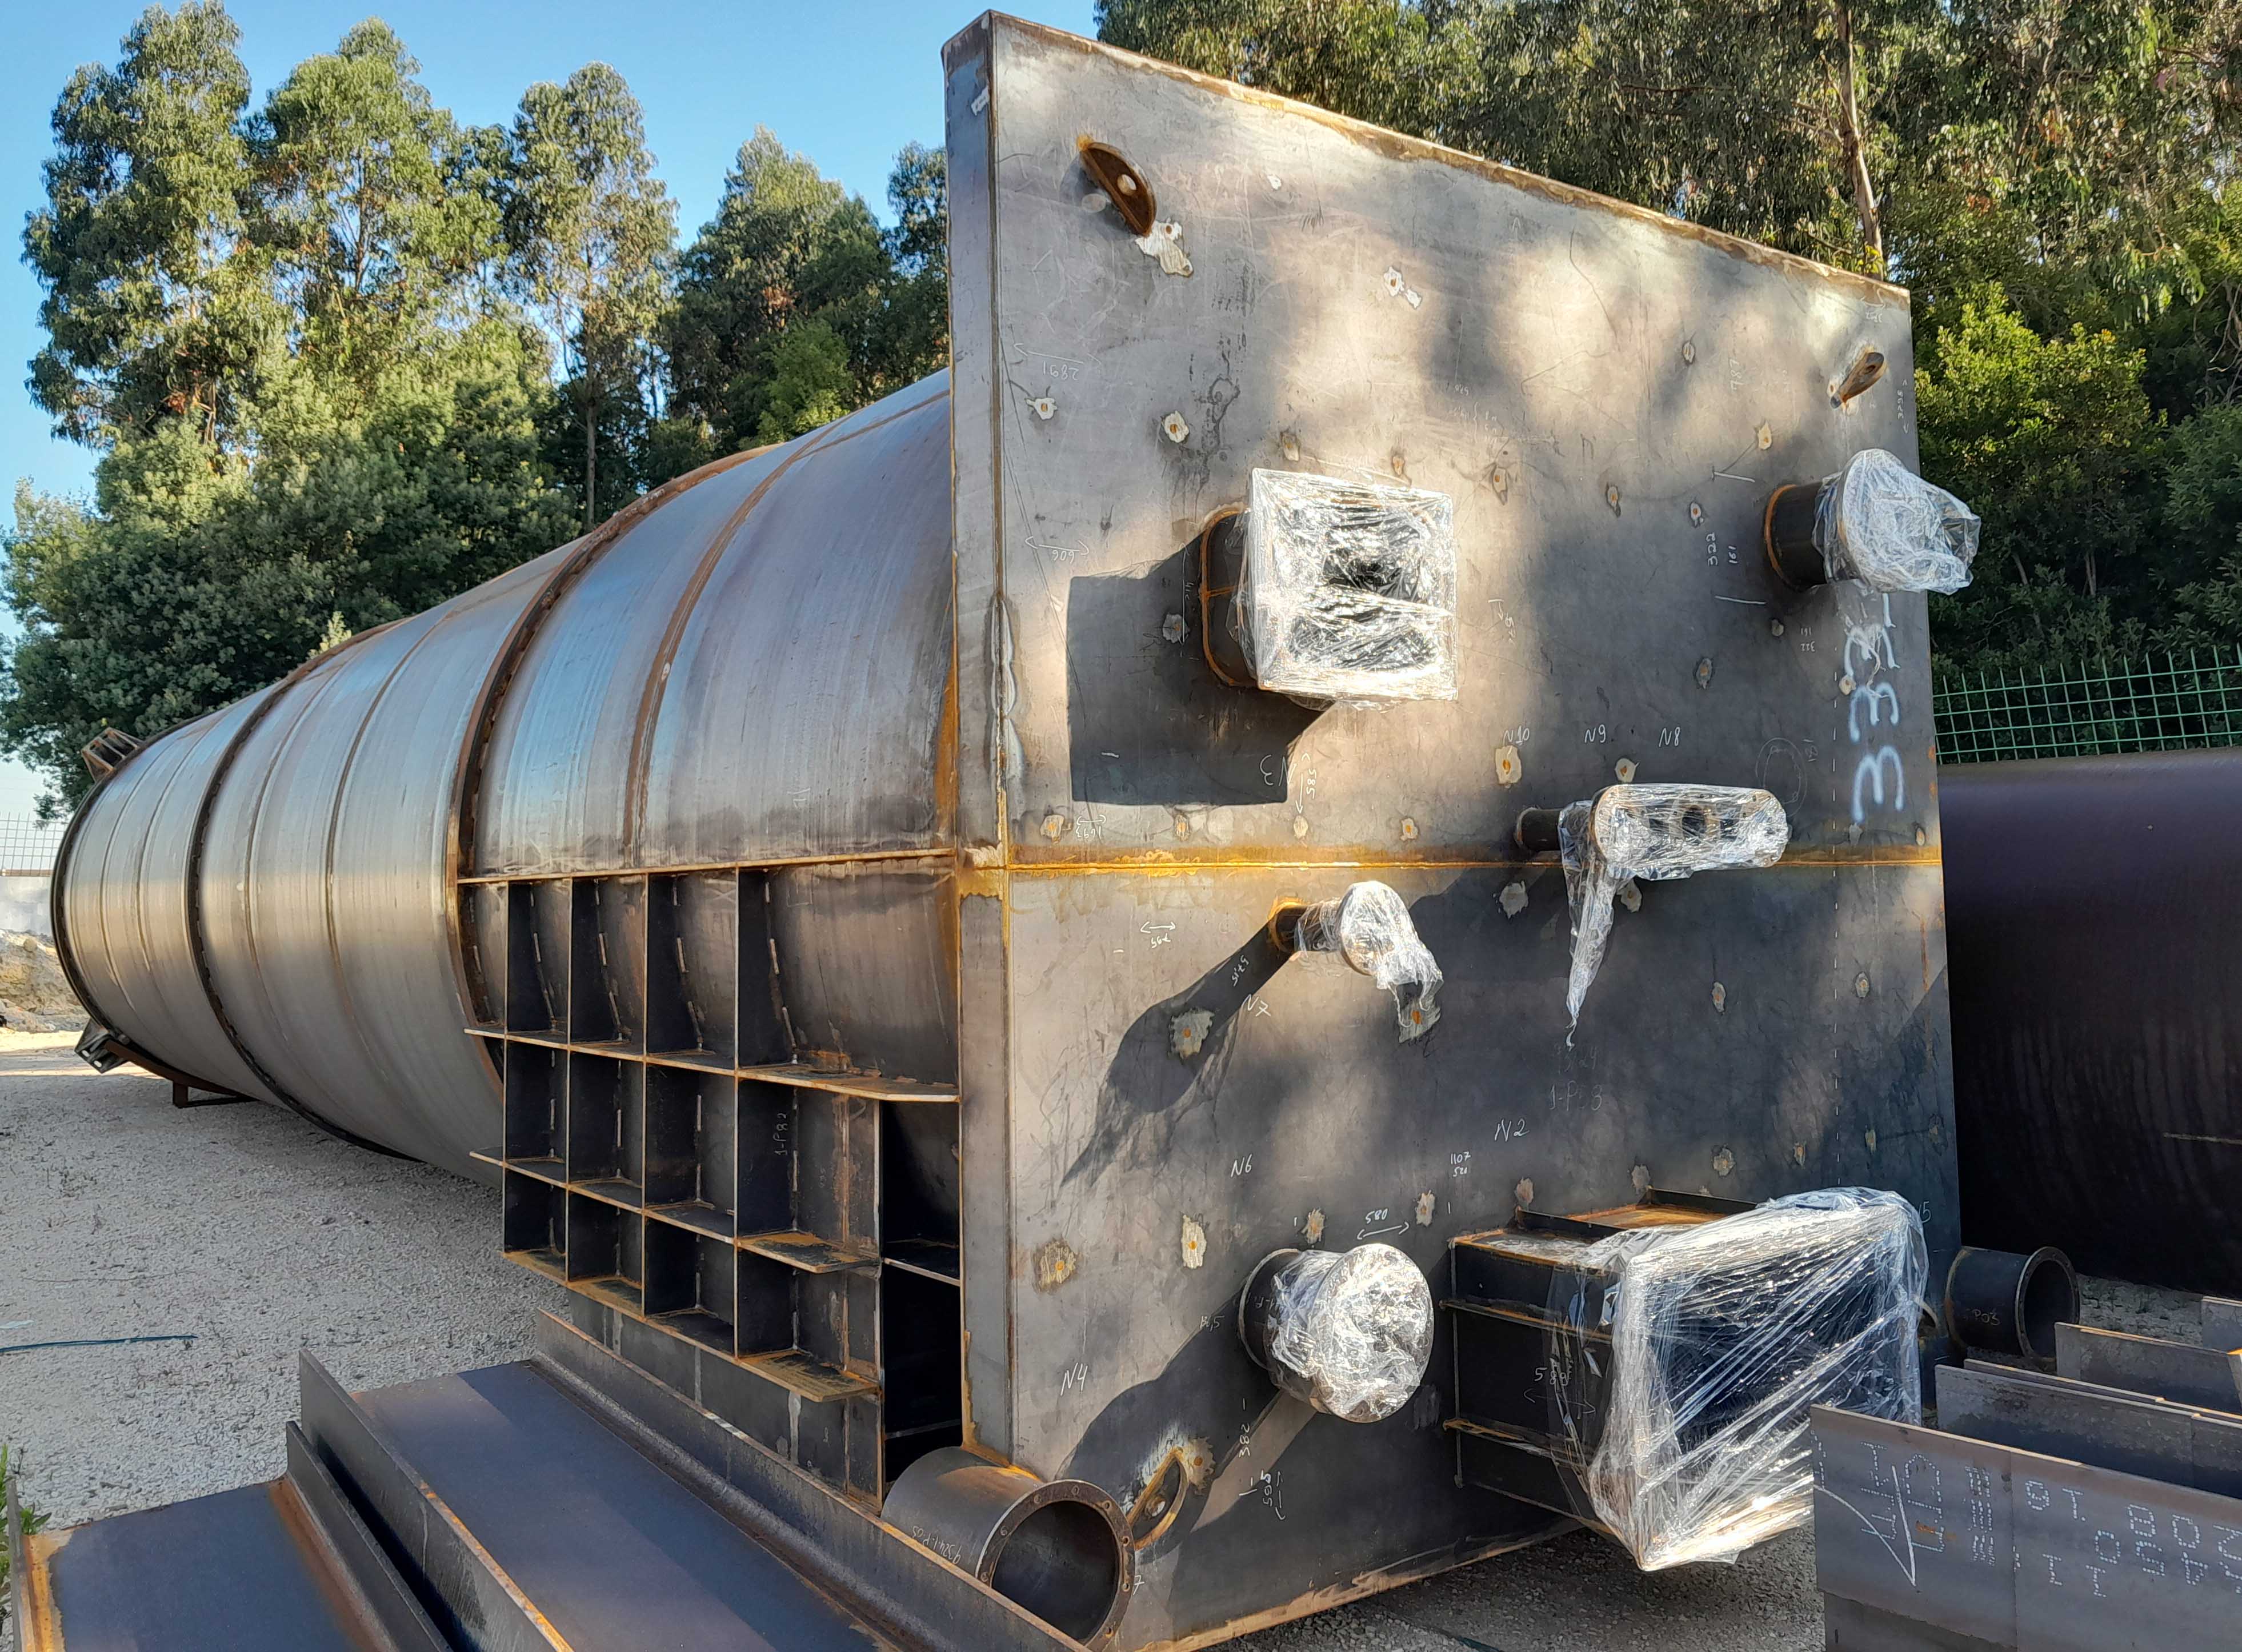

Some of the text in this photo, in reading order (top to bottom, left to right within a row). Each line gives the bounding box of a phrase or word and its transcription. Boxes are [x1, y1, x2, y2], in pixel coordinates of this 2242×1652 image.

[1705, 532, 1719, 567] 322
[1727, 546, 1737, 565] 161
[1503, 724, 1531, 745] N10
[1584, 723, 1607, 744] N9
[1658, 725, 1682, 748] N8
[1304, 767, 1318, 799] 585
[1242, 993, 1272, 1018] N7
[1494, 1118, 1531, 1142] N2
[1230, 1153, 1254, 1178] N6
[1450, 1150, 1471, 1165] 1107
[1364, 1207, 1388, 1225] 580
[1060, 1361, 1090, 1397] N4
